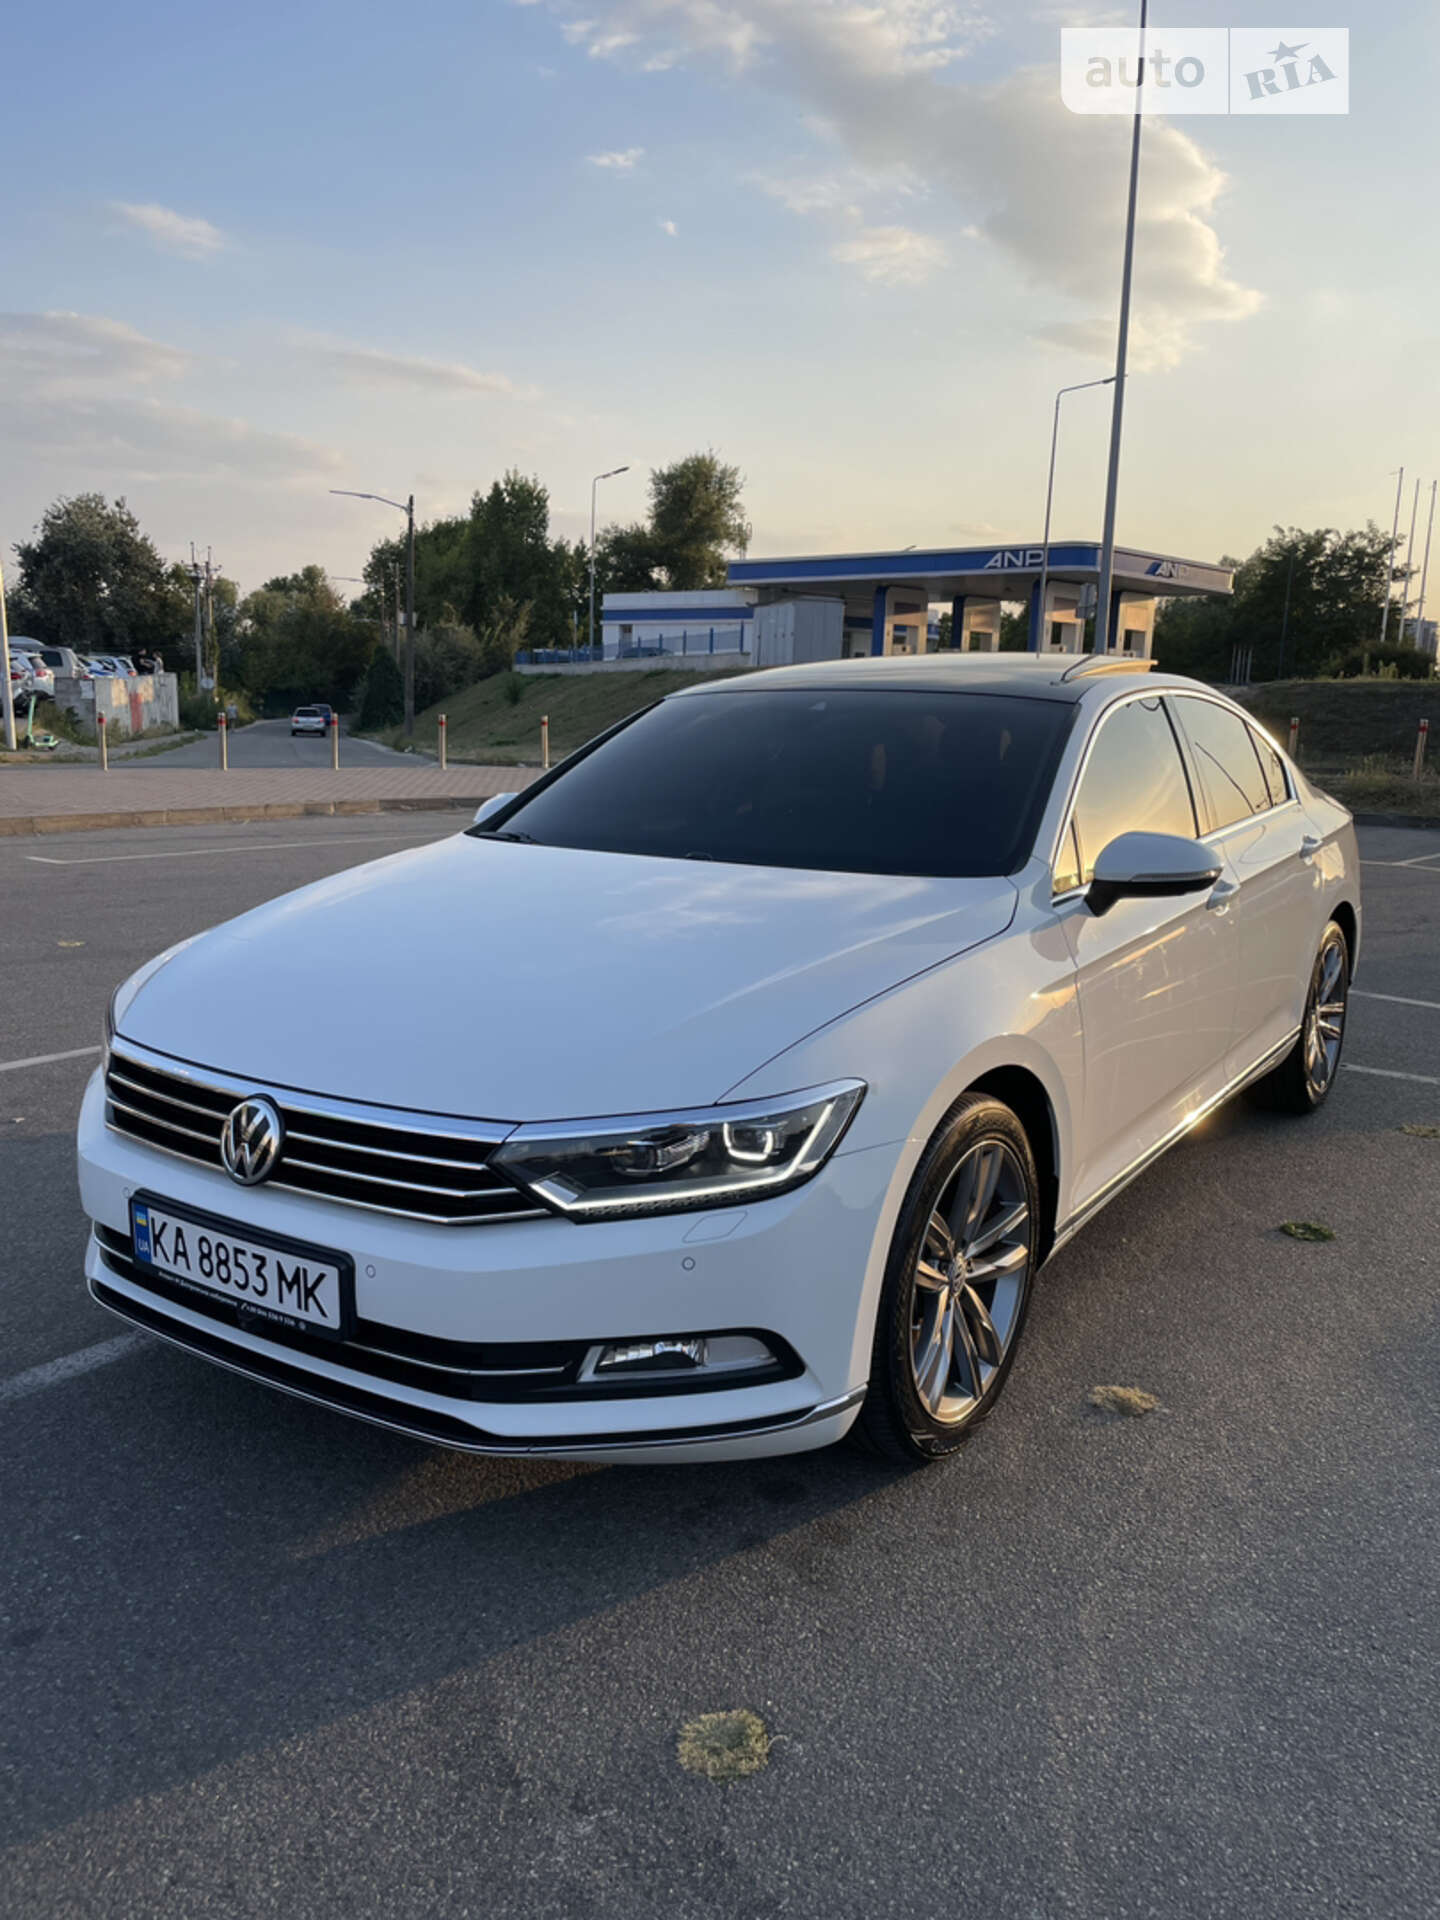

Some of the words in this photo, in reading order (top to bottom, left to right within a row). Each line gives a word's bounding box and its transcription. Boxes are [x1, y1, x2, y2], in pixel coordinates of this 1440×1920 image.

[984, 549, 1045, 569] ANP
[150, 1216, 192, 1272] KA
[198, 1235, 269, 1298] 8853
[276, 1259, 329, 1319] MK
